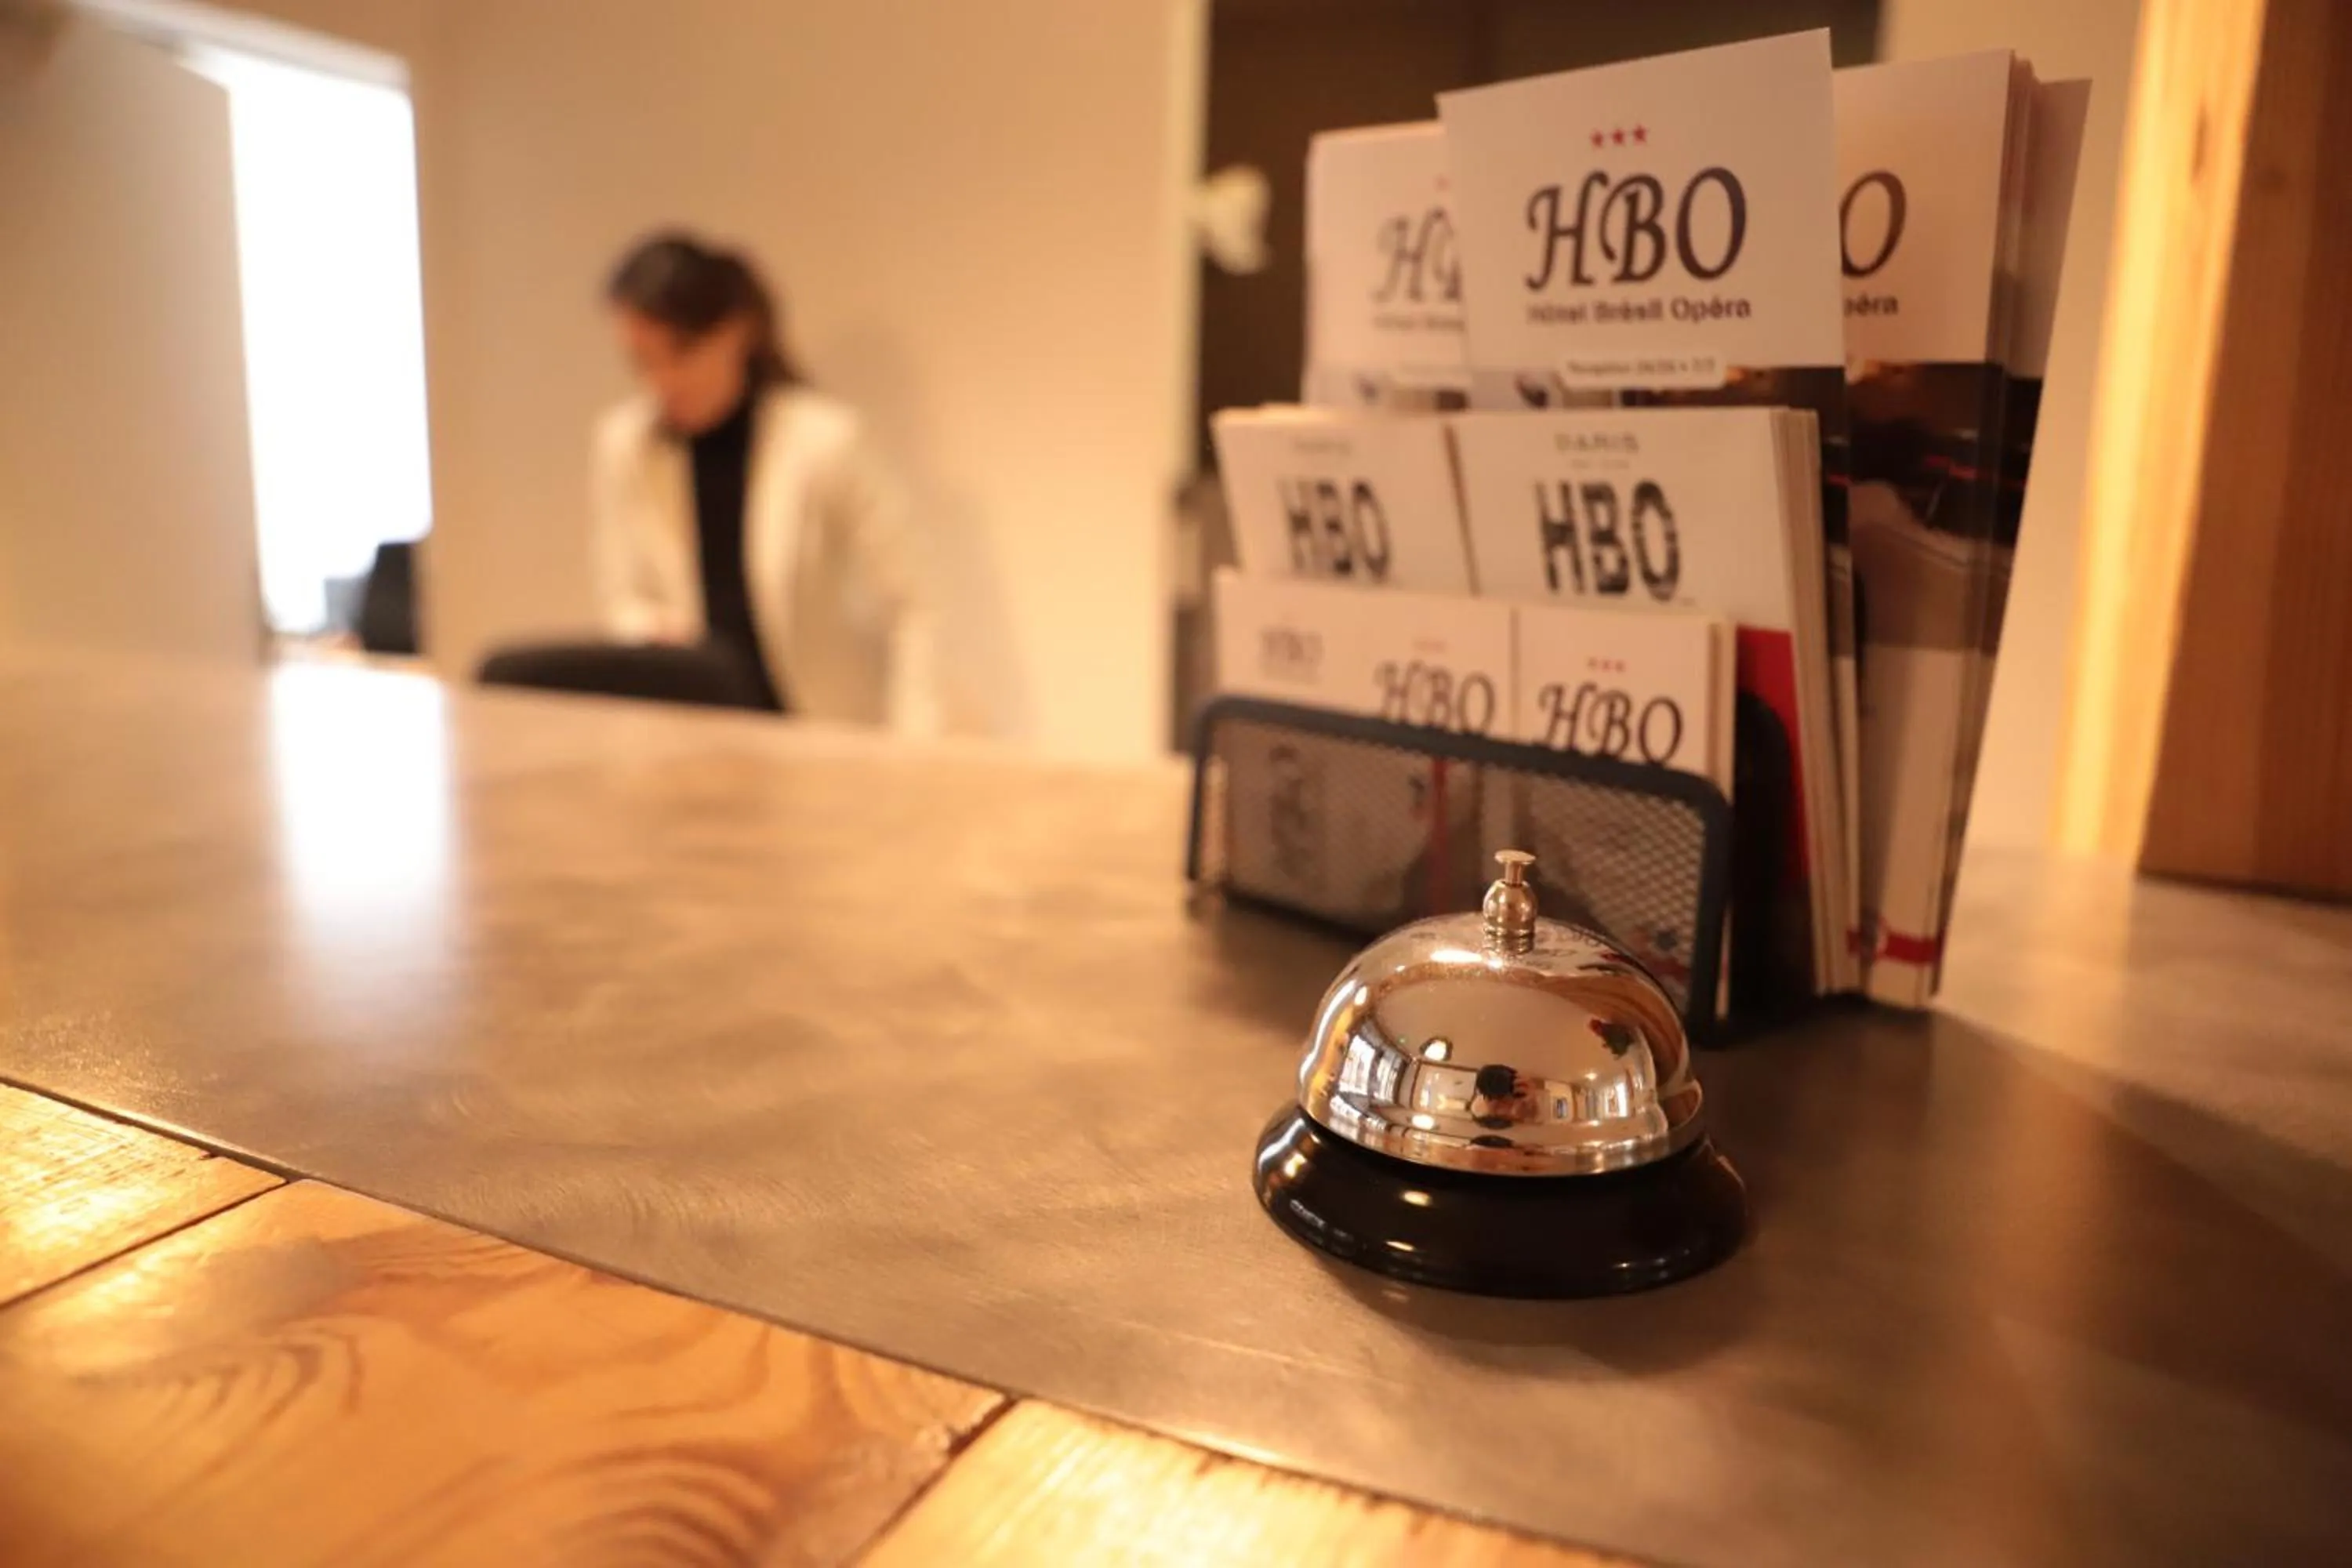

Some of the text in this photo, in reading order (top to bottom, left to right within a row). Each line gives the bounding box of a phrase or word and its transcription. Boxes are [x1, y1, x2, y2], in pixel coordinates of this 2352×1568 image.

[1525, 166, 1747, 291] HBO
[1671, 296, 1751, 325] Opéra
[1843, 292, 1899, 318] péra
[1276, 478, 1391, 583] HBO
[1534, 478, 1680, 603] HBO
[1538, 681, 1682, 766] HBO
